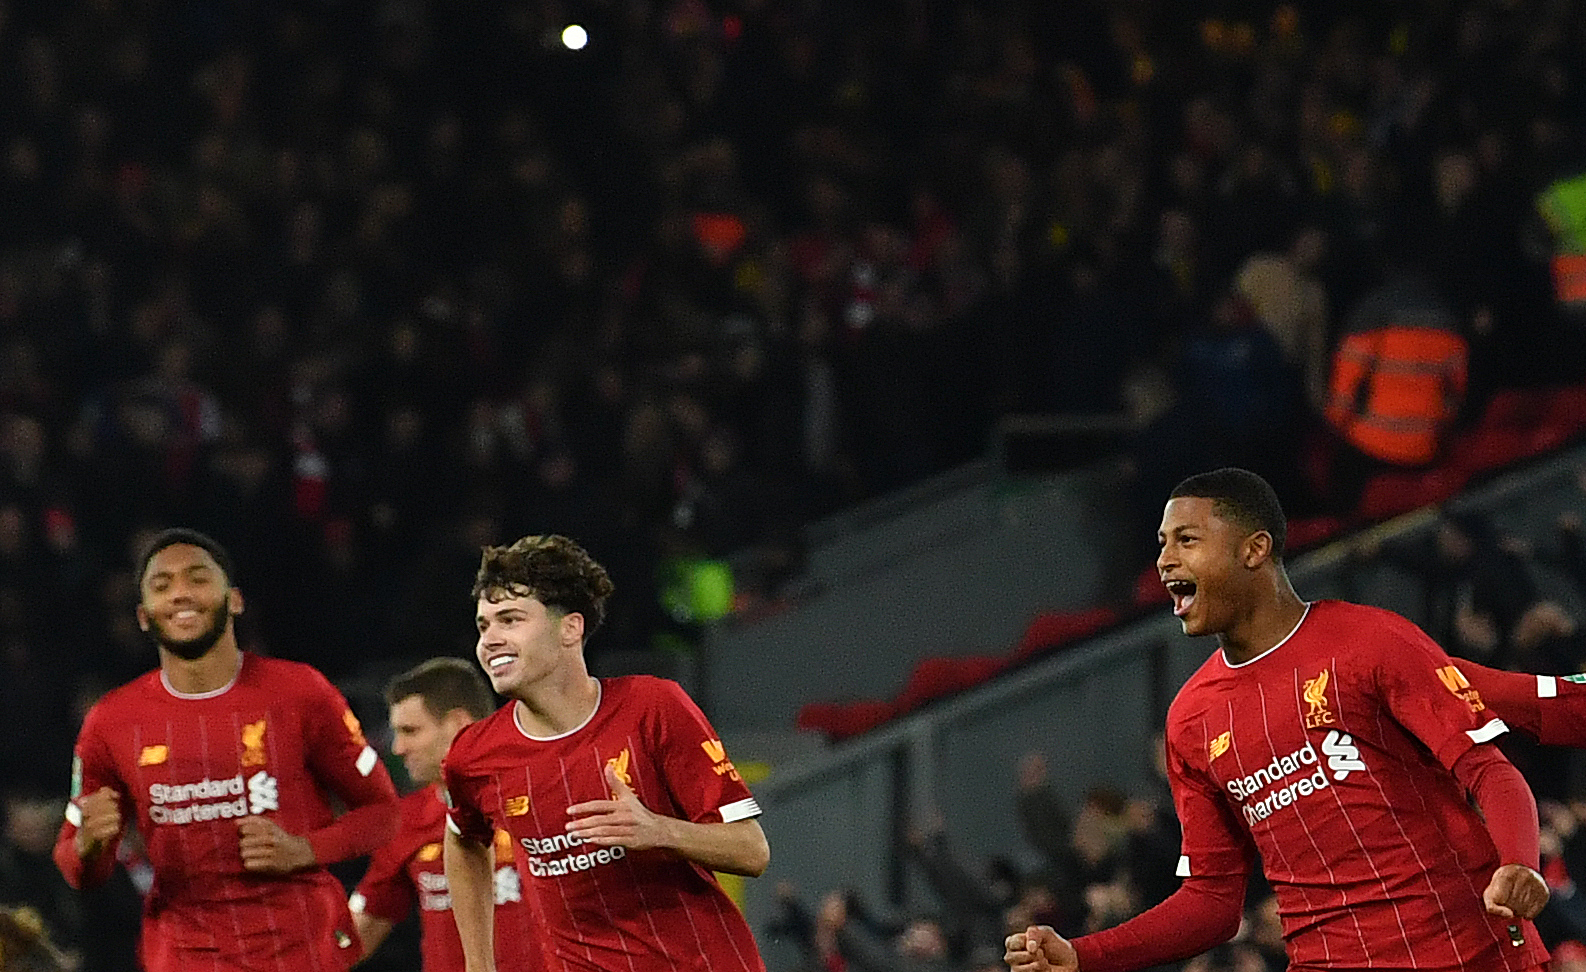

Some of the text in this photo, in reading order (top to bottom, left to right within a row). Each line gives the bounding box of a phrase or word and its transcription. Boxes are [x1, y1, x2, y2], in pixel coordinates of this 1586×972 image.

[149, 773, 245, 805] Standard
[1227, 741, 1317, 801] Standard
[150, 796, 249, 825] Chartered
[1242, 767, 1330, 827] Chartered
